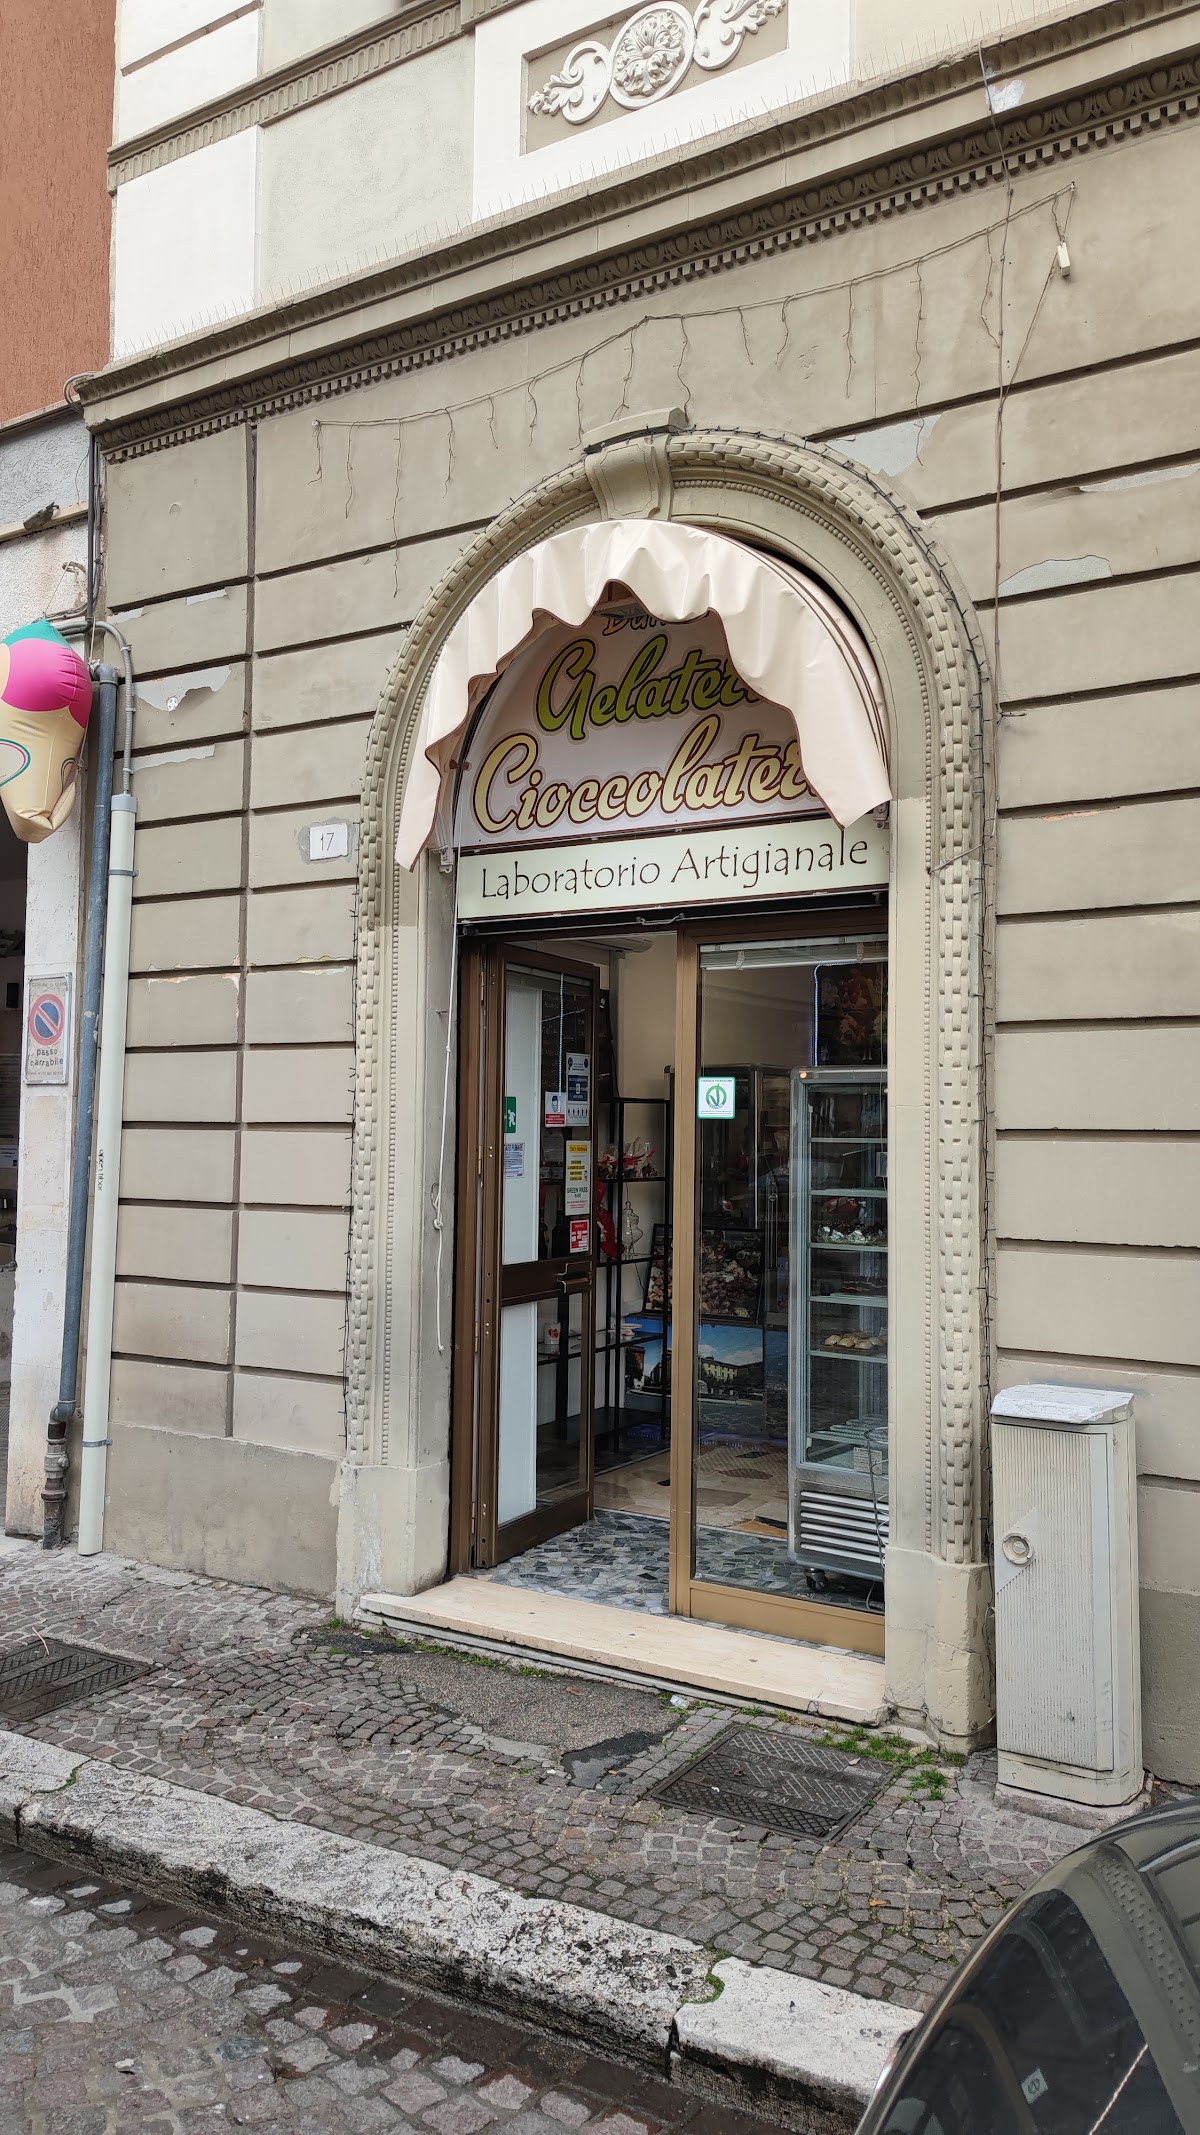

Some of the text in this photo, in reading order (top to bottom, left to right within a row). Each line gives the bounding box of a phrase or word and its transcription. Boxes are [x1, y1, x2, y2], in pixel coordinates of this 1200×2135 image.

[536, 634, 760, 740] Gelater
[473, 713, 817, 834] Cioccolater
[320, 832, 335, 851] 17
[670, 829, 868, 889] Artigianale
[482, 857, 660, 900] Laboratorio
[30, 1057, 64, 1067] carrabile
[36, 1048, 58, 1057] passo
